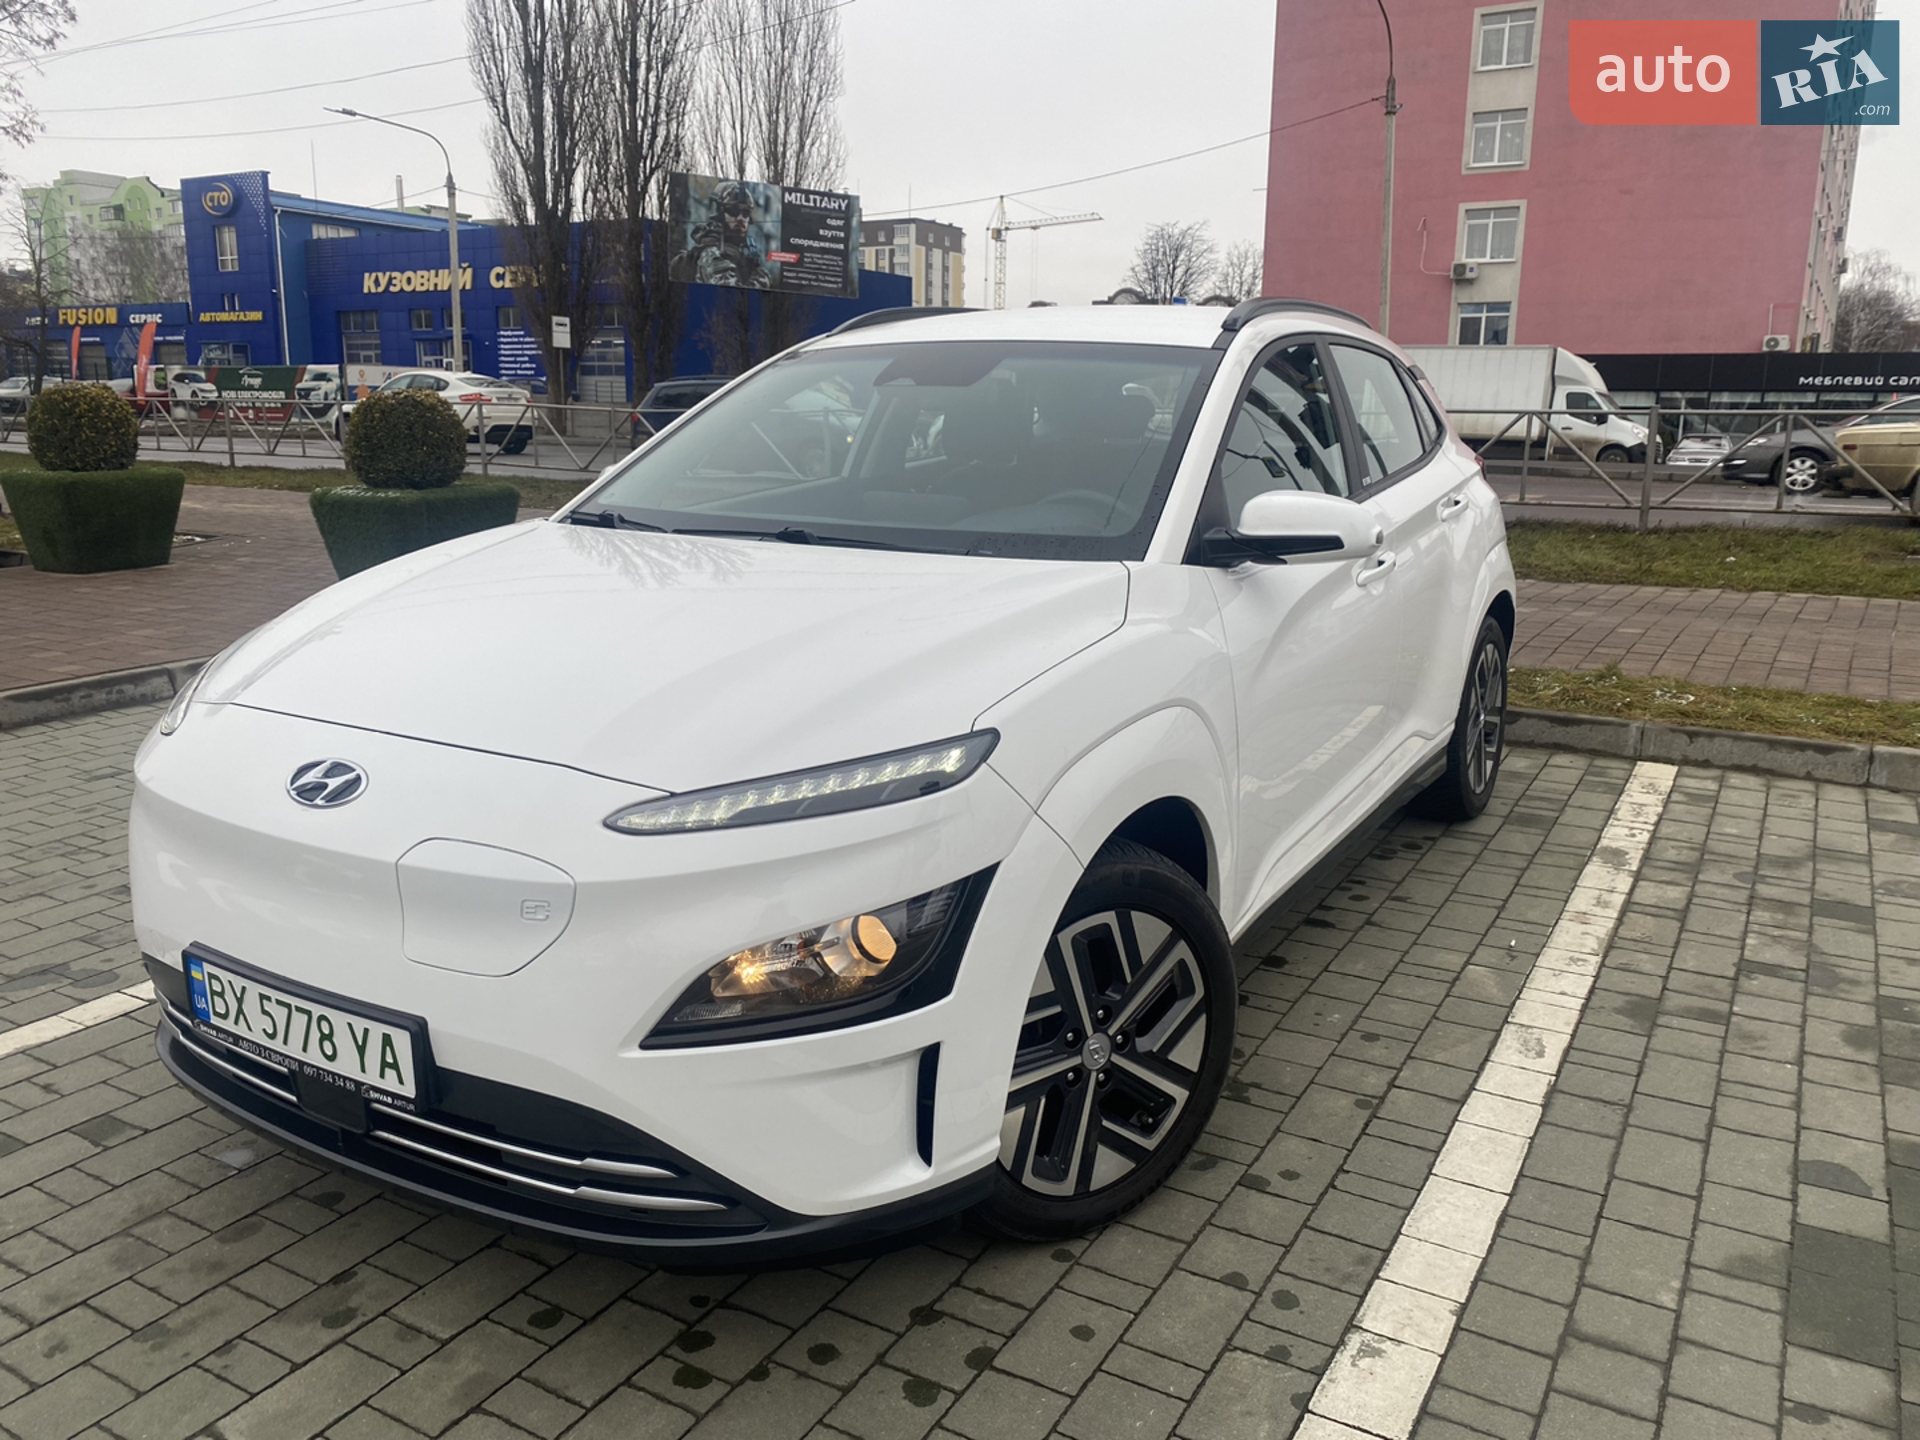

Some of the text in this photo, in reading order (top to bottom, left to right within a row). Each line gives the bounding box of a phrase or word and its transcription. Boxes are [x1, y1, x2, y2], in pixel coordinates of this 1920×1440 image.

[206, 191, 229, 207] СТО
[784, 191, 848, 210] MILITARY
[58, 307, 118, 325] FUSION
[199, 311, 263, 322] АВТОМАГАЗИН
[194, 994, 209, 1012] UA
[206, 971, 405, 1086] BX 5778 YA
[238, 1039, 259, 1054] АВТО
[319, 1070, 333, 1084] 734
[334, 1075, 344, 1088] 34
[369, 1090, 392, 1104] SHVAB
